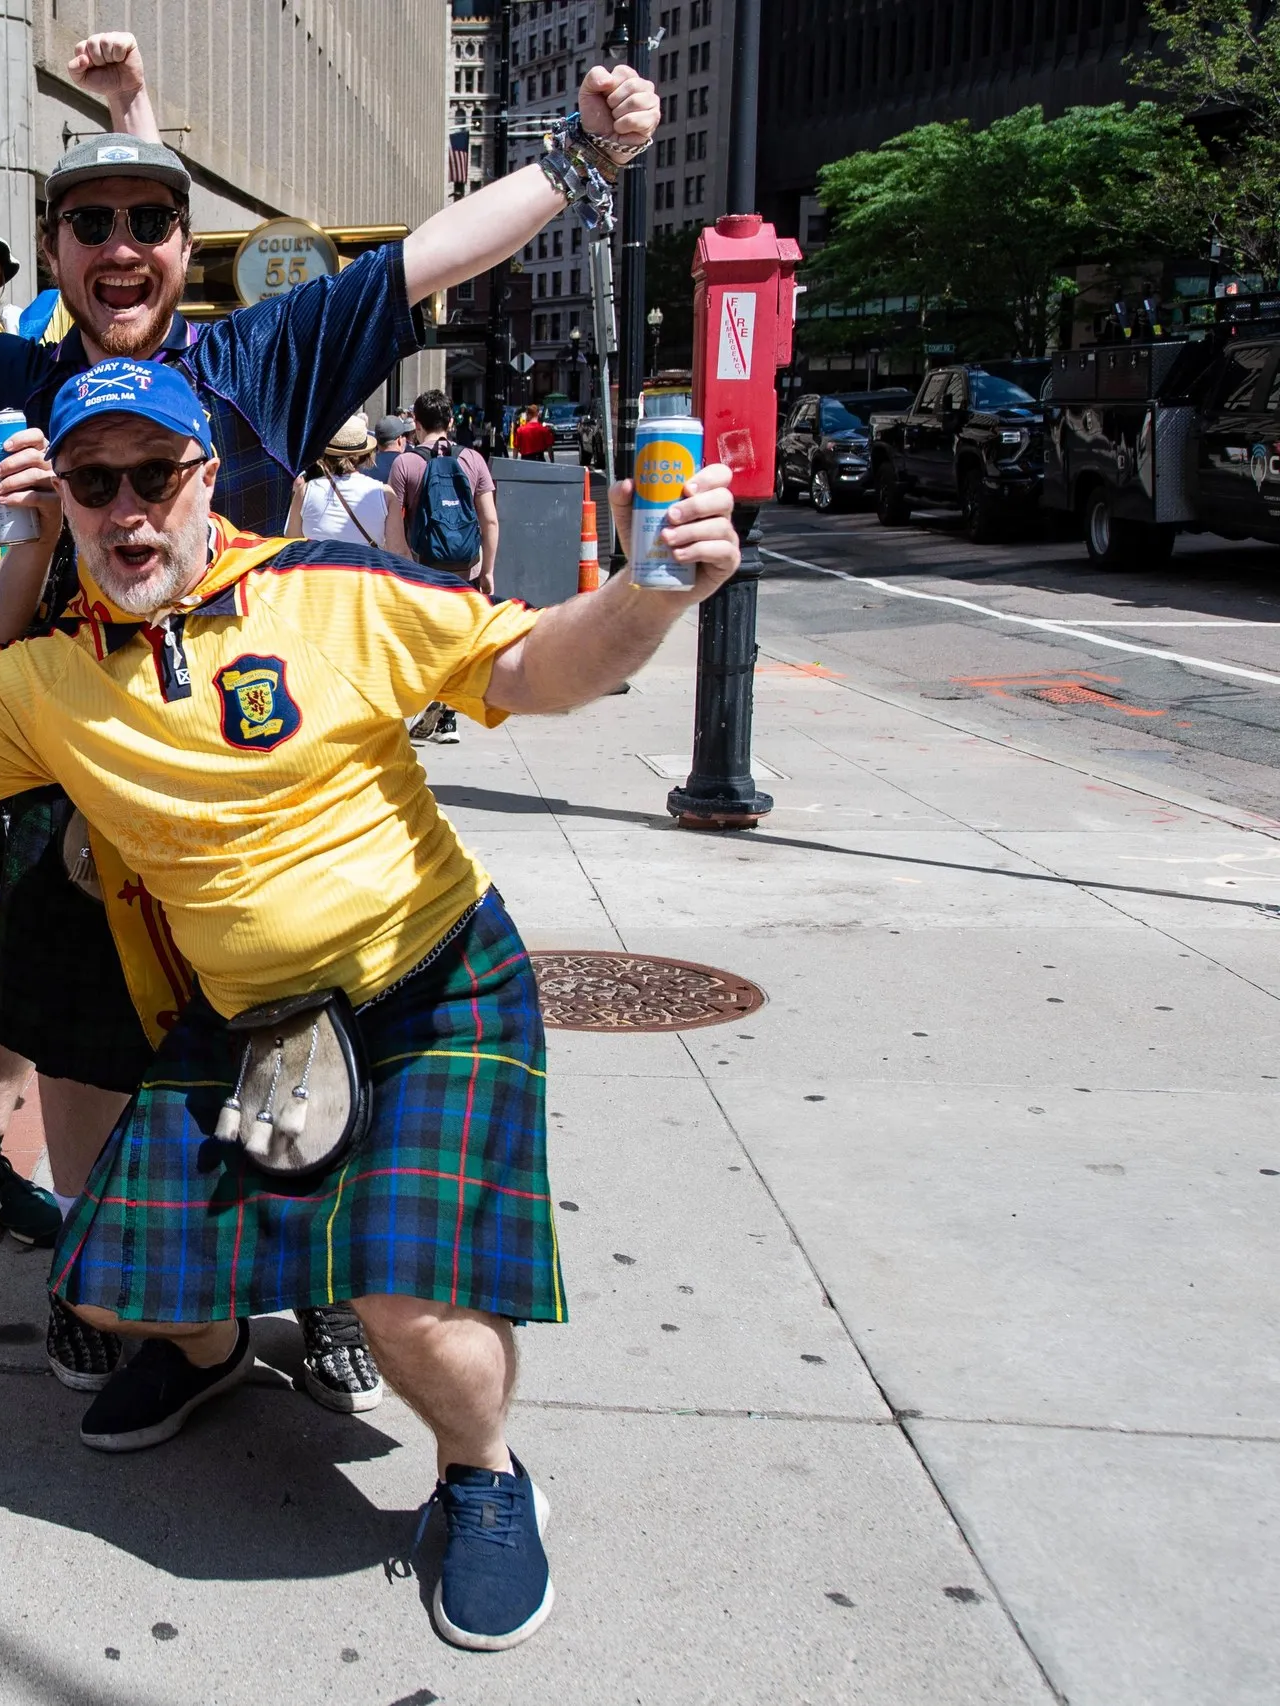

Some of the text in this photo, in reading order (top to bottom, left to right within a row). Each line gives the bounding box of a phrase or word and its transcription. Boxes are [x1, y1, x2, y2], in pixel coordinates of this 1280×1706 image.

[258, 237, 314, 253] COURT
[265, 256, 309, 288] 55
[730, 297, 748, 338] FIRE
[724, 320, 742, 375] EMERGENCY
[75, 362, 153, 386] FENWAY PARK
[121, 392, 136, 401] MA
[643, 460, 682, 471] HIGH
[639, 473, 686, 484] NOON
